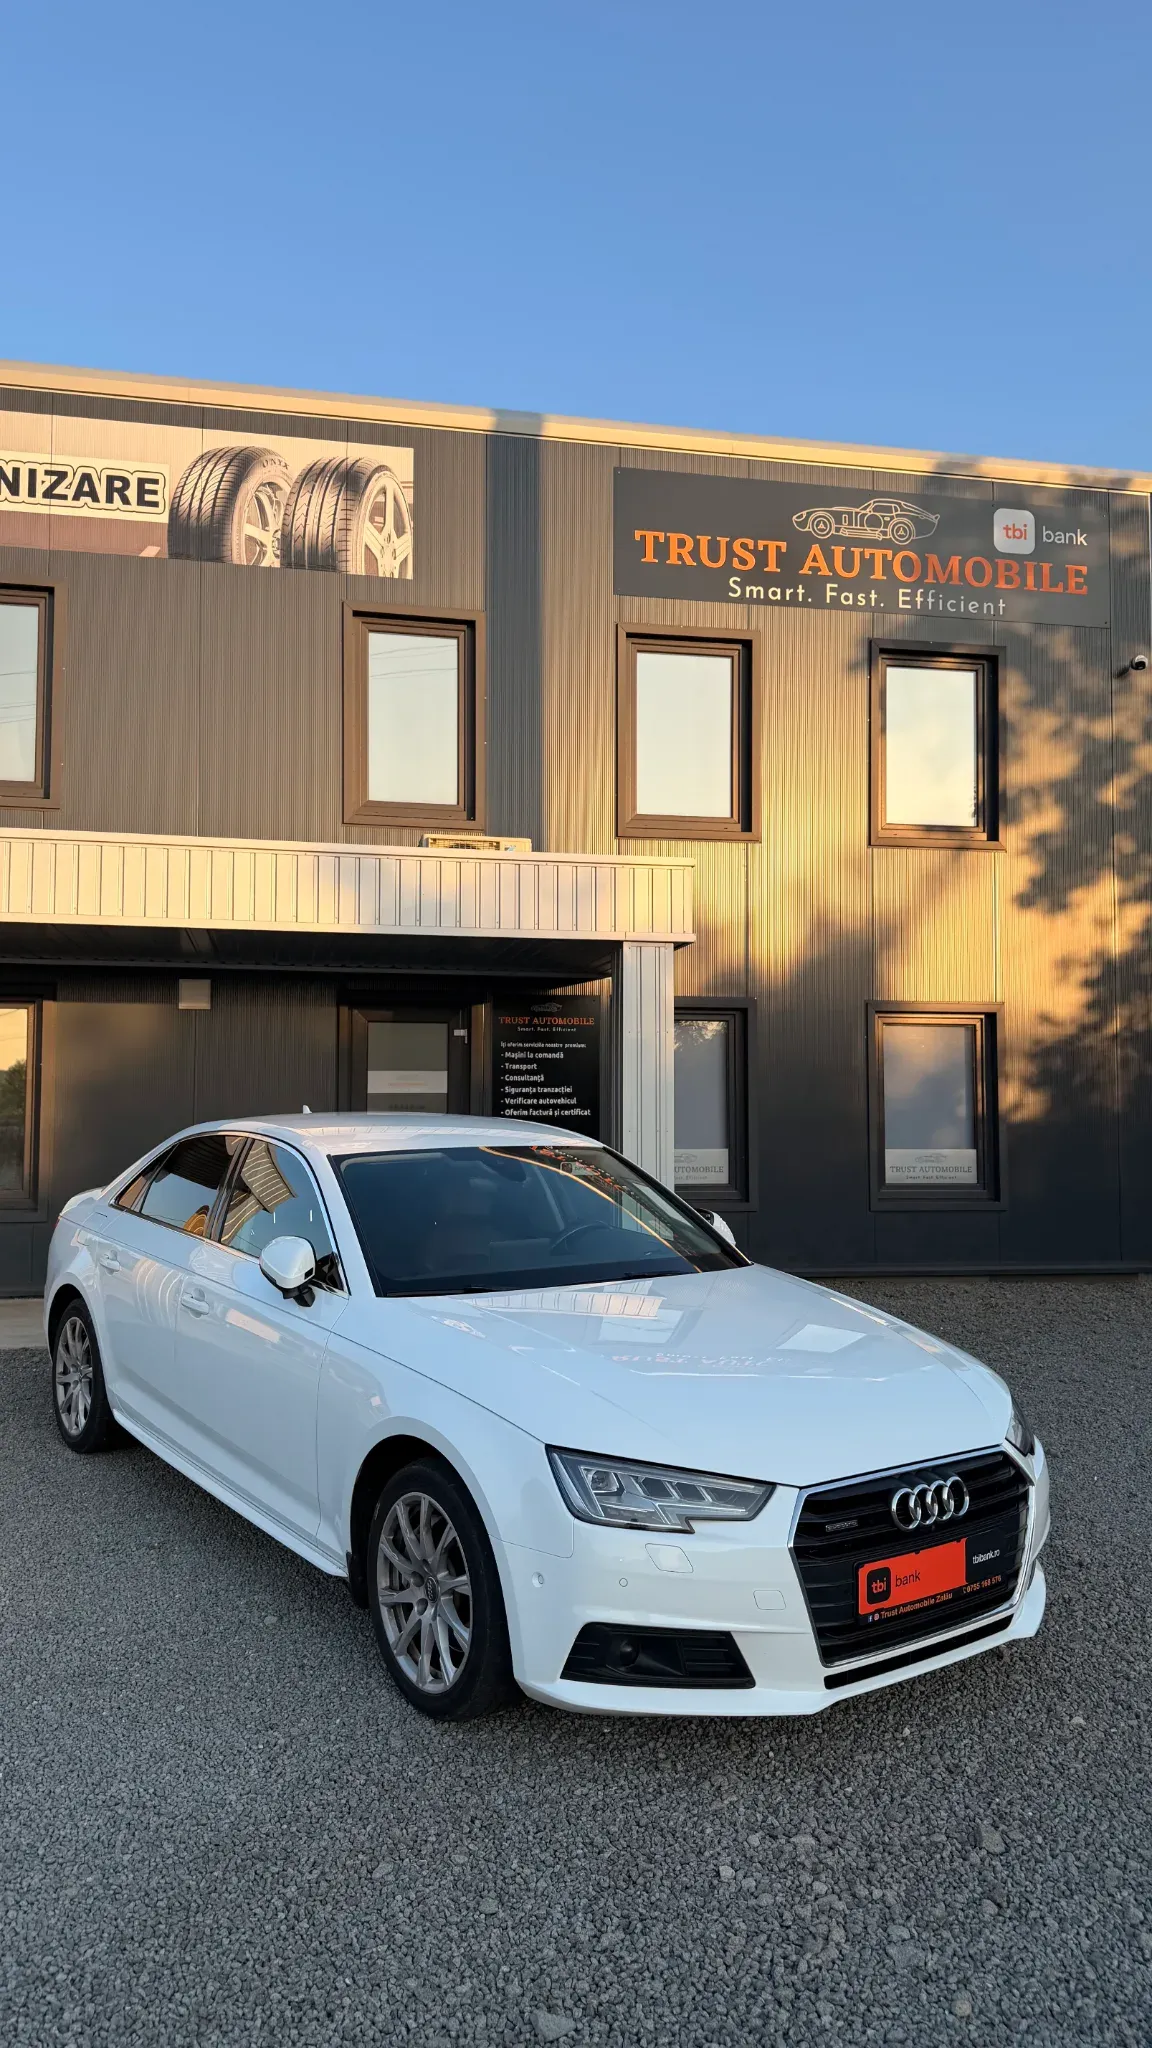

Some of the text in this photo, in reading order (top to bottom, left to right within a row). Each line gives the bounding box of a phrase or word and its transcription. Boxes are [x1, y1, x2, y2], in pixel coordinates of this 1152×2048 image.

[0, 465, 160, 508] NIZARE
[1003, 523, 1088, 546] tbi bank
[634, 529, 1088, 595] TRUST AUTOMOBILE
[728, 576, 1006, 616] Smart. Fast. Efficient
[498, 1016, 595, 1025] TRUST AUTOMOBILE
[534, 1051, 564, 1059] comandă
[504, 1063, 538, 1071] Transport
[504, 1097, 577, 1105] Verificare autovehicul
[504, 1108, 528, 1116] Oferim
[529, 1108, 553, 1116] factură
[560, 1108, 591, 1116] certificat
[674, 1165, 725, 1174] UTOMOBILE
[889, 1165, 973, 1174] TRUST AUTOMOBILE
[972, 1549, 1000, 1564] tbibank.ro
[871, 1569, 921, 1594] tbi bank
[966, 1582, 981, 1593] 0755
[881, 1609, 898, 1619] Trust
[899, 1598, 935, 1613] Automobile
